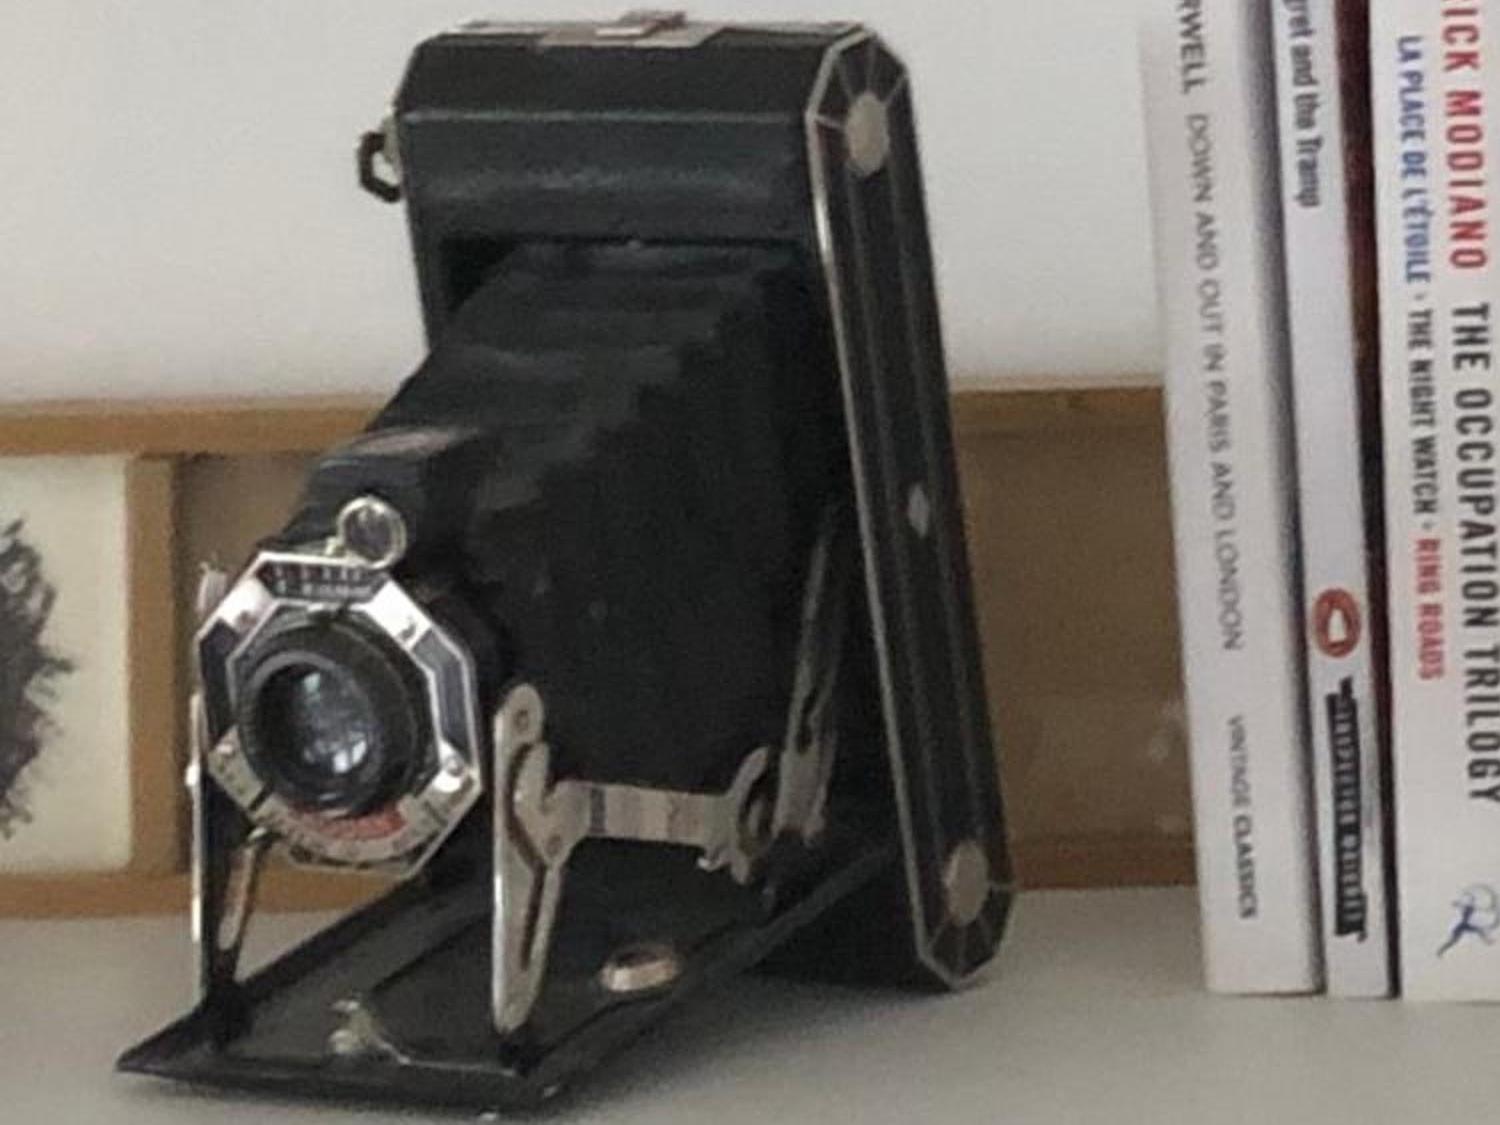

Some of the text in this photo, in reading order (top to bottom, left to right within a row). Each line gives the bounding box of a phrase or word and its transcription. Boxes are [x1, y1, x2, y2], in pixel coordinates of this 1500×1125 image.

[1291, 45, 1320, 87] and
[1397, 35, 1426, 65] LA
[1294, 93, 1321, 130] the
[1399, 74, 1427, 144] PLACE
[1292, 136, 1323, 210] Tramp
[1401, 151, 1428, 180] DE
[1445, 90, 1488, 270] MODIANO
[1451, 302, 1492, 371] THE
[1187, 113, 1245, 651] DOWN AND OUT IN PARIS AND LONDON
[1408, 309, 1440, 516] THE NIGHT WATCH
[1415, 536, 1445, 681] RING ROADS
[1227, 716, 1259, 921] VINTAGE CLASSICS
